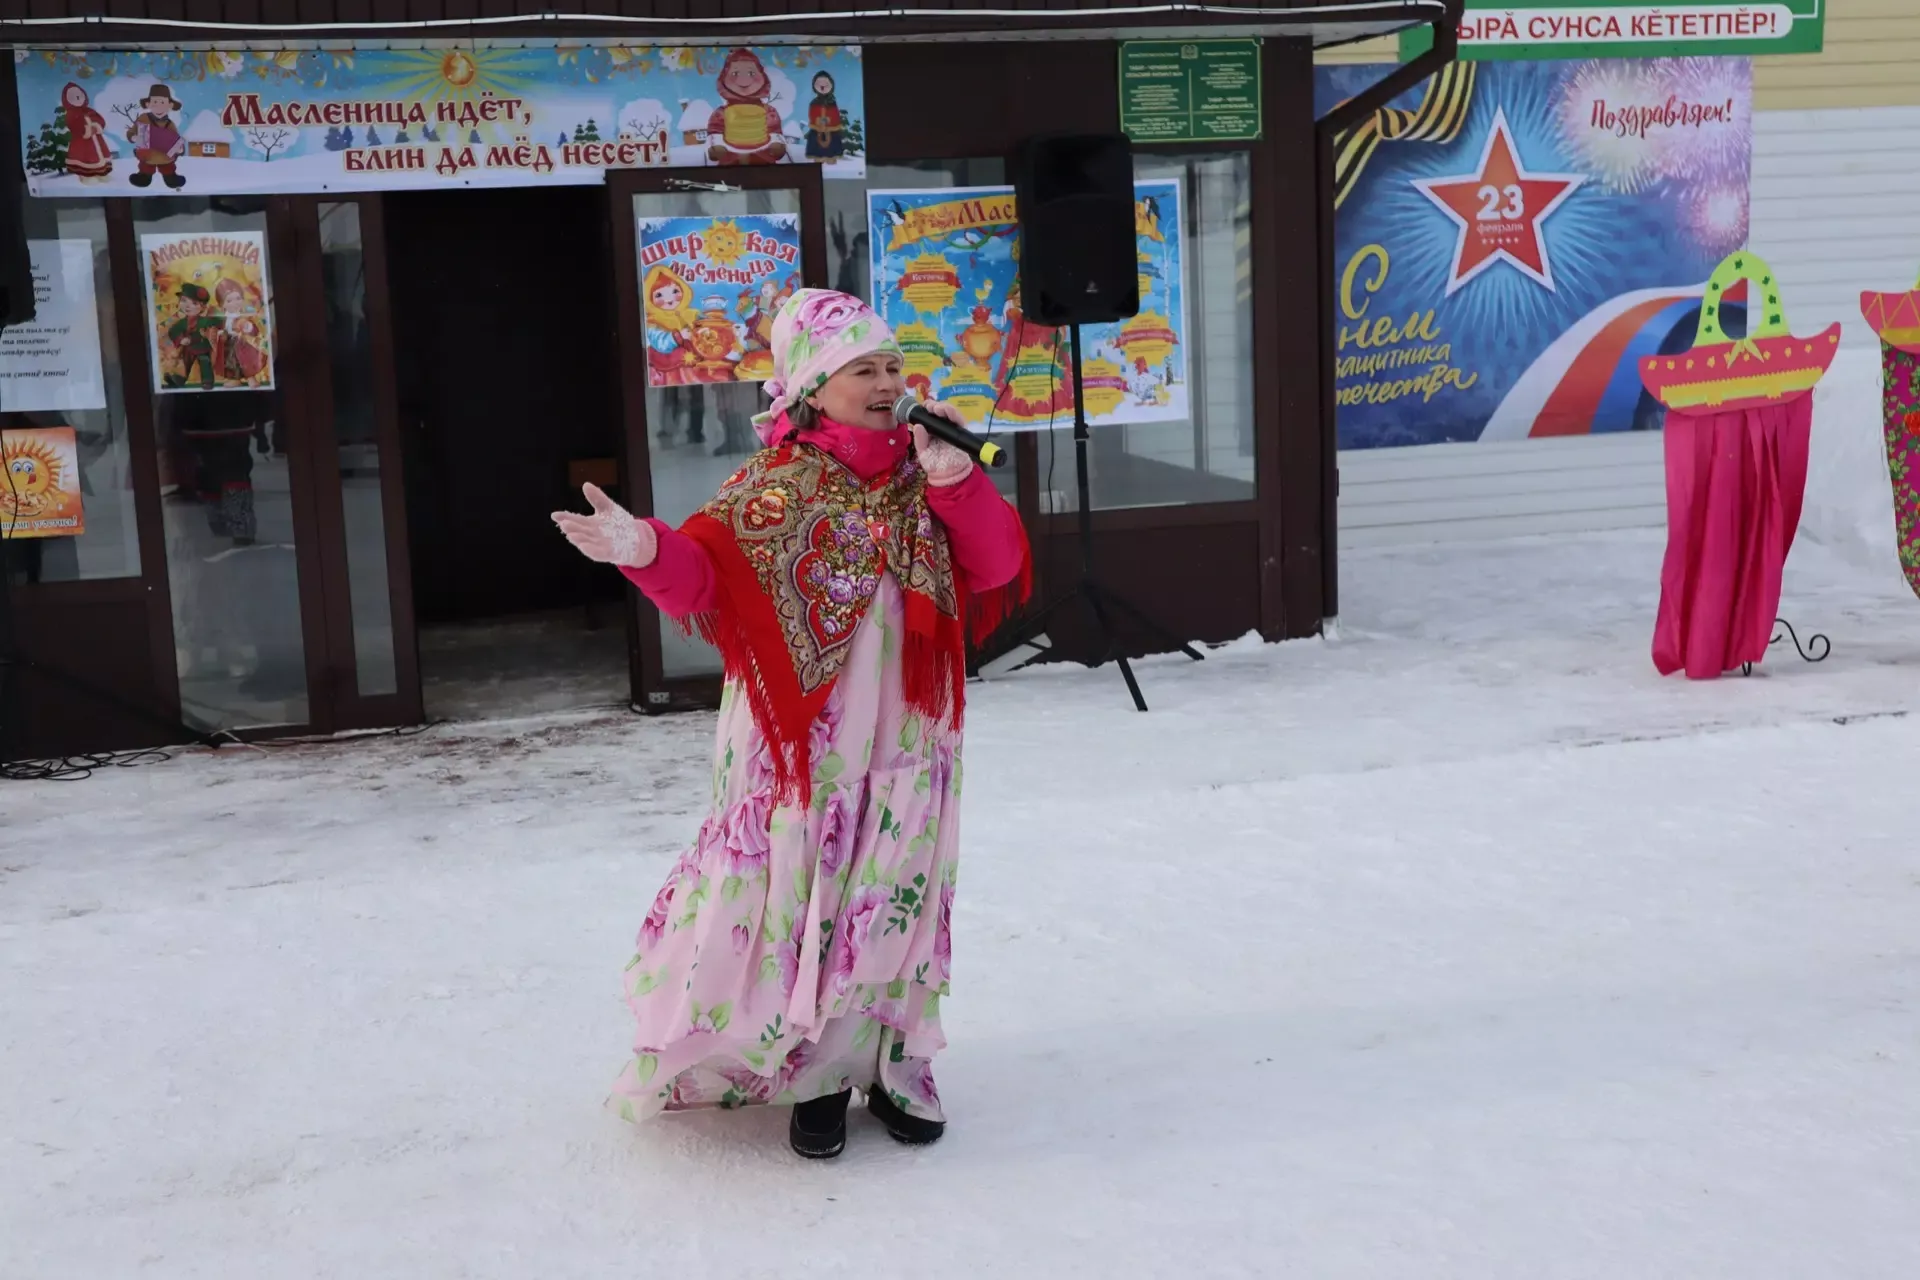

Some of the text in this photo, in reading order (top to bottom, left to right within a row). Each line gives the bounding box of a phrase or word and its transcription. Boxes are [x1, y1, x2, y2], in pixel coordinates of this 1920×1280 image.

[1527, 15, 1622, 38] СУНСА
[1630, 7, 1777, 37] КӖТЕТПӖР!
[221, 91, 532, 130] Масленица идёт,
[1591, 94, 1733, 139] Поздравляем!
[345, 129, 670, 176] блин да мёд несёт!
[1475, 184, 1525, 221] 23
[1475, 222, 1525, 236] февраля
[150, 236, 260, 267] МАСЛЕНИЦА
[1340, 243, 1390, 320] С
[1338, 308, 1441, 350] нем
[1336, 363, 1478, 406] течества
